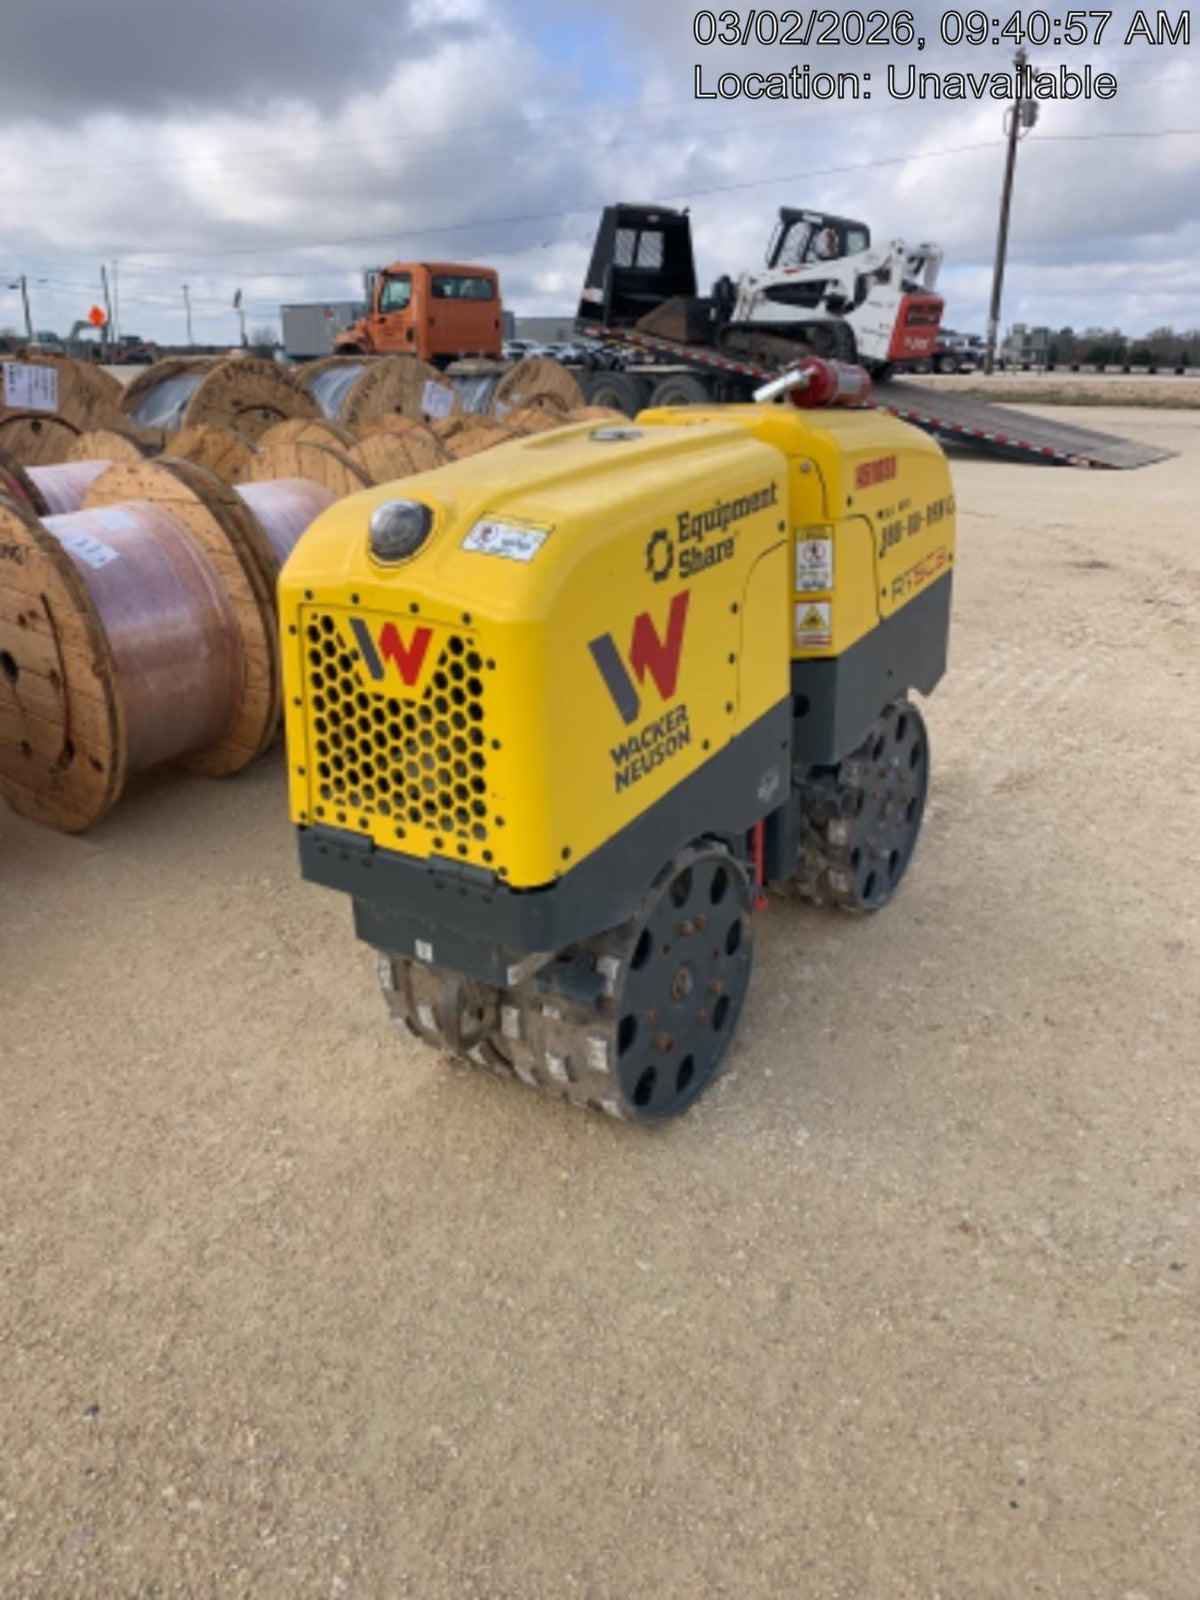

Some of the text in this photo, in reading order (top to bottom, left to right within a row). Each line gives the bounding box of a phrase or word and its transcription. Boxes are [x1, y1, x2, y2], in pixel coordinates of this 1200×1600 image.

[677, 481, 778, 543] Equipment
[678, 537, 735, 579] Share
[610, 703, 689, 766] WACKER
[614, 722, 691, 794] NEUSON
